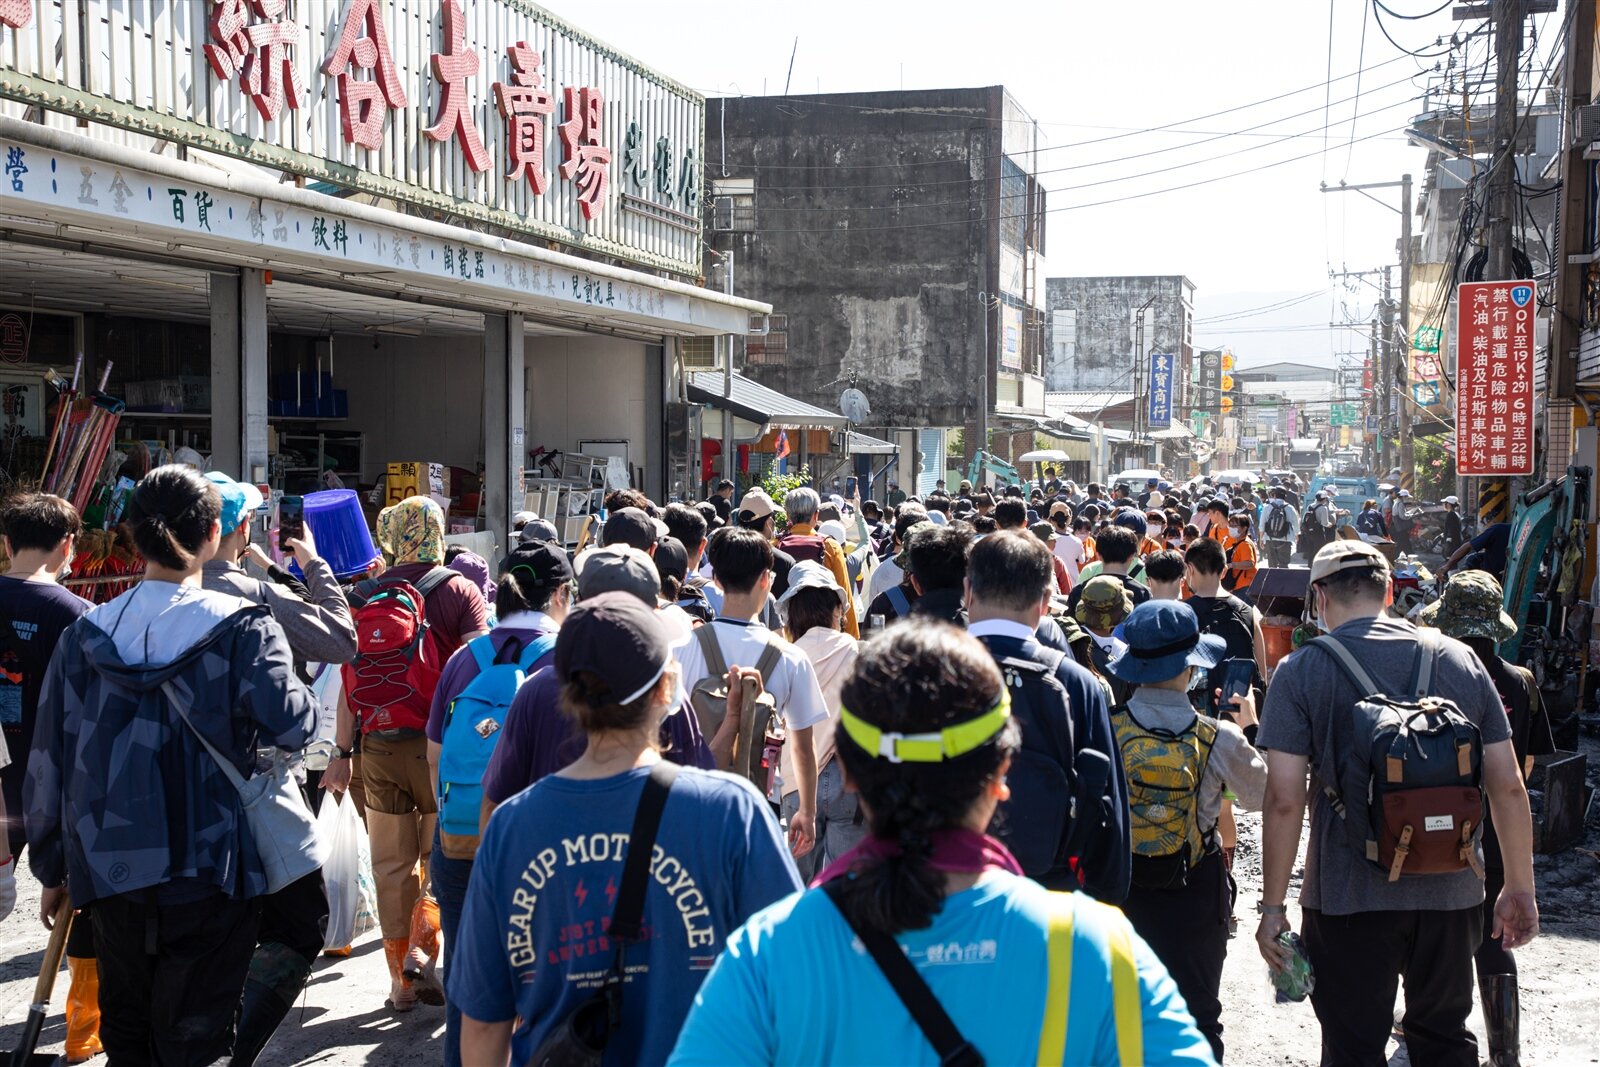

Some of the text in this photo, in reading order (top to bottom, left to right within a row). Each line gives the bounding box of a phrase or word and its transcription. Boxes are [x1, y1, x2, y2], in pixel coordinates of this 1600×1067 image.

[78, 166, 133, 213] 五金
[168, 188, 213, 232] 百貨
[246, 201, 287, 242] 食品
[312, 217, 348, 256] 飲料
[373, 232, 421, 269] 小家電
[443, 245, 484, 279] 陶瓷器
[572, 275, 614, 306] 兒童玩具
[1517, 289, 1526, 297] 11
[1153, 356, 1169, 420] 東寶商行
[1491, 288, 1509, 469] 禁行載運危險物品車輛
[390, 463, 416, 477] 二顆
[508, 833, 715, 967] GEAR UP MOTRCYCLE
